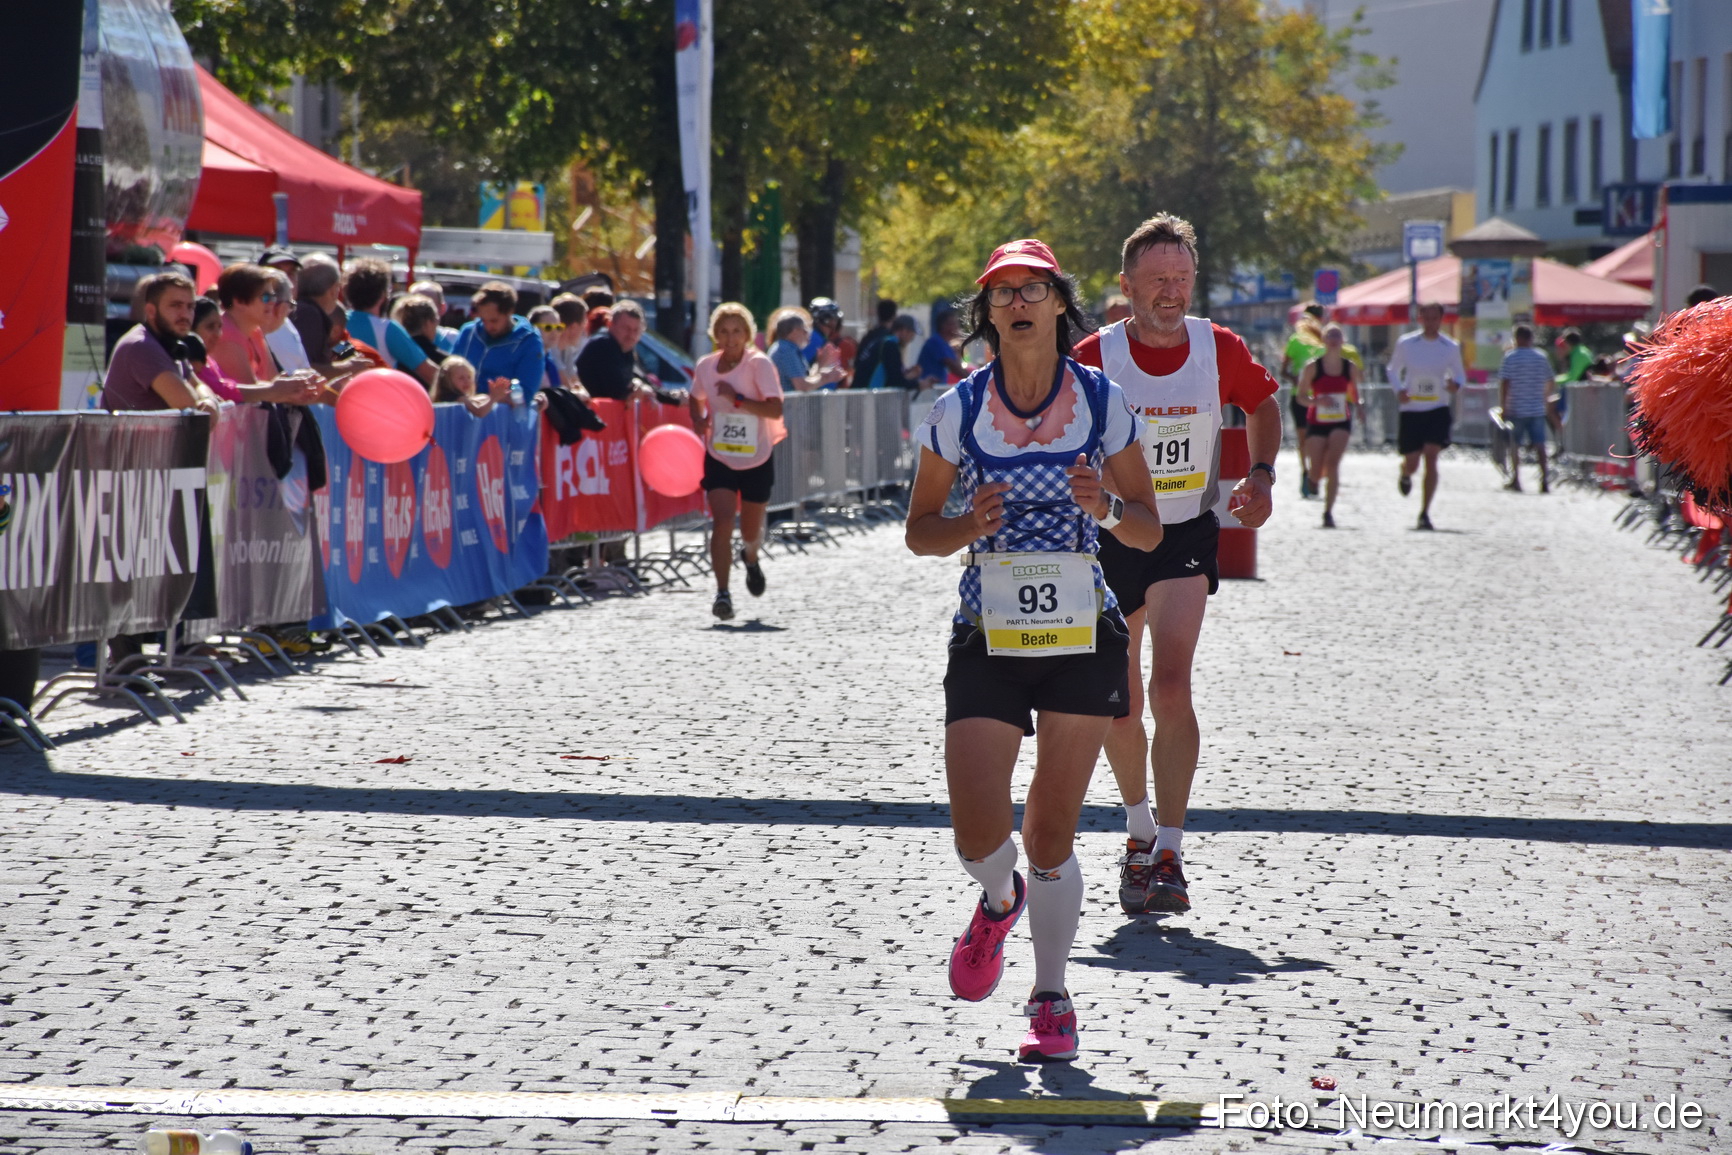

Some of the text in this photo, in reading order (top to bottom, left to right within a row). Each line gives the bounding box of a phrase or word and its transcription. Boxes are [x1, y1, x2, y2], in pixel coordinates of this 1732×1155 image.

[723, 425, 746, 439] 254
[1158, 423, 1190, 434] BOCK
[1153, 438, 1190, 466] 191
[1166, 467, 1189, 475] Neumarkt
[1155, 480, 1187, 491] Rainer
[1013, 564, 1062, 577] BOCK
[1018, 583, 1058, 614] 93
[1021, 632, 1058, 646] Beate
